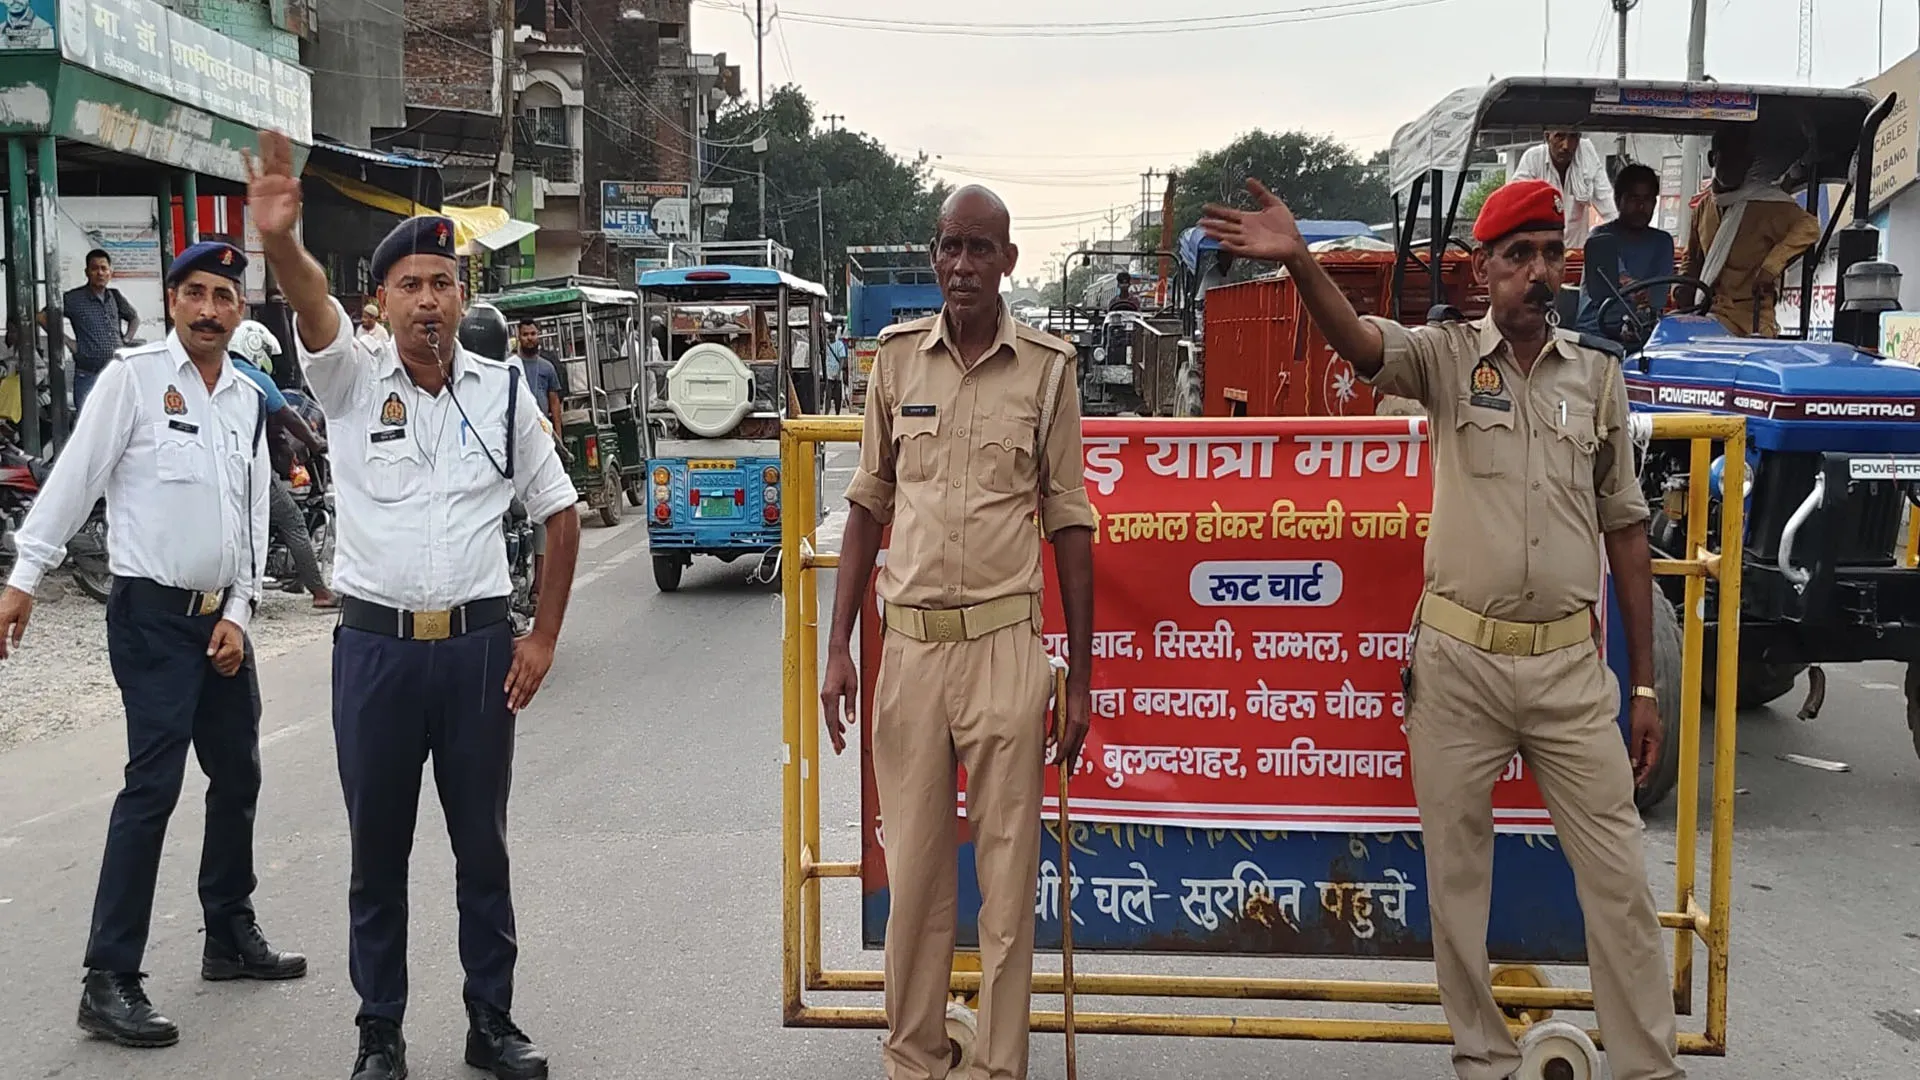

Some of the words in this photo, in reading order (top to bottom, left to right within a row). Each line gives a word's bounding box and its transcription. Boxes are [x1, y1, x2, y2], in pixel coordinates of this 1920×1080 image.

[1888, 99, 1908, 120] ABEL
[1874, 120, 1908, 153] CABLES
[605, 210, 648, 225] NEET
[1658, 386, 1725, 407] POWERTRAC
[1805, 402, 1915, 416] POWERTRAC
[1144, 435, 1280, 480] यात्रा
[1294, 418, 1427, 479] मार्ग
[1107, 511, 1190, 544] सम्भल
[1195, 500, 1266, 542] होकर
[1270, 498, 1345, 542] दिल्ली
[1351, 500, 1410, 540] जाने
[1208, 573, 1263, 602] रूट
[1267, 562, 1323, 602] चार्ट
[1154, 619, 1243, 661] सिरसी,
[1252, 631, 1349, 662] सम्भल,
[1132, 687, 1237, 720] बबराला,
[1246, 679, 1318, 720] नेहरू
[1325, 679, 1386, 718] चौक
[1103, 744, 1247, 788] बुलन्दशहर,
[1256, 737, 1405, 779] गाजियाबाद
